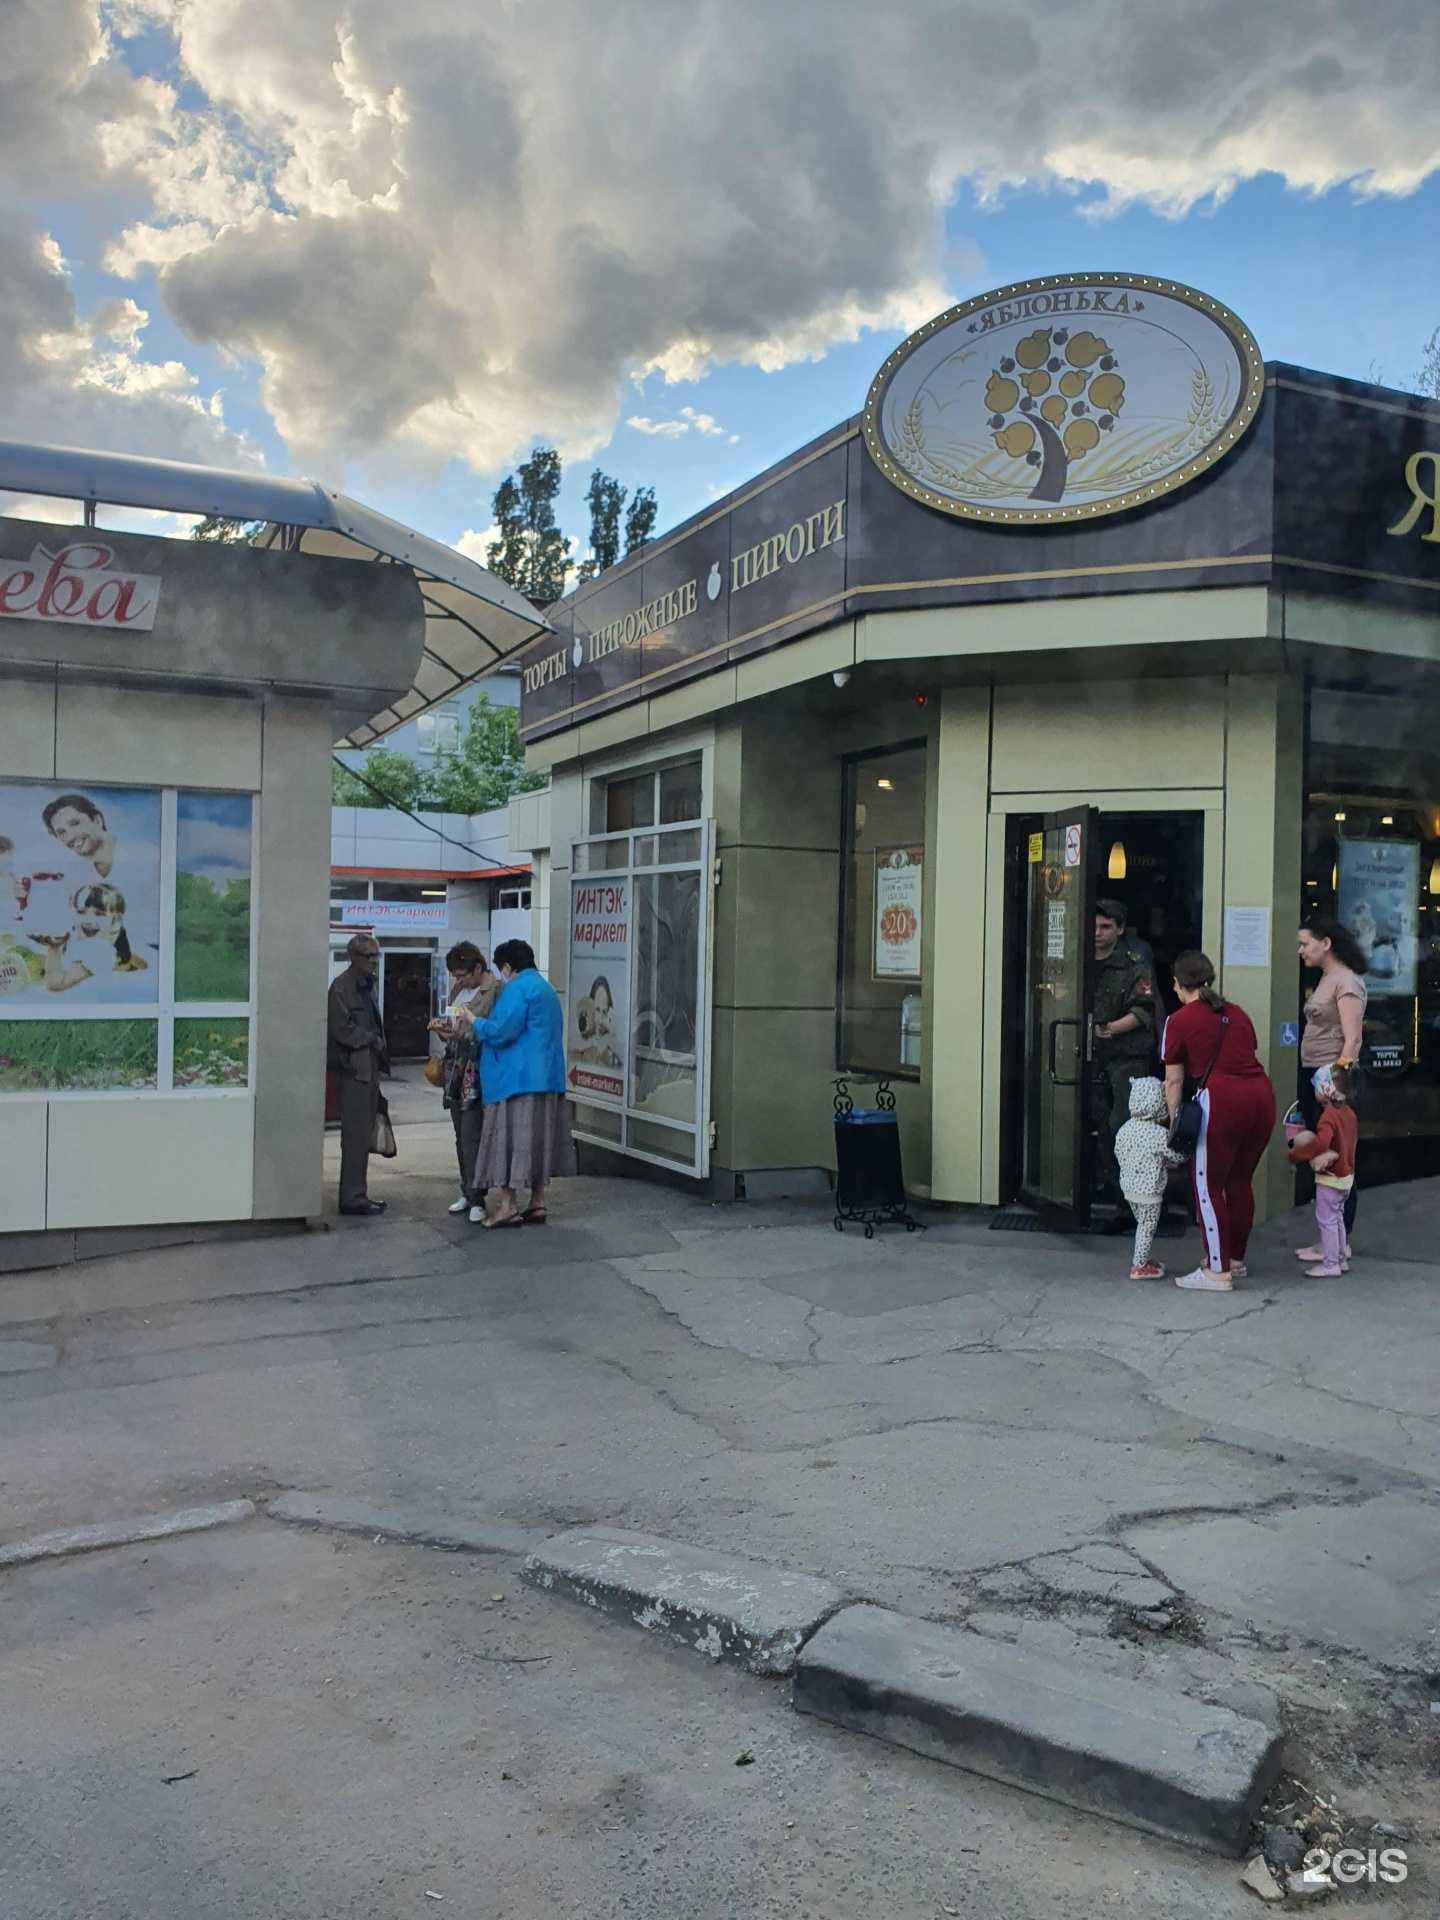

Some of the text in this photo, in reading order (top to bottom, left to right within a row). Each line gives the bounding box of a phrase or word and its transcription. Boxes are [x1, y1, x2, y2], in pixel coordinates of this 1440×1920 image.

[1386, 451, 1440, 542] Я
[523, 499, 848, 694] ТОРТЫ ПИРОЖНЫЕ ПИРОГИ
[574, 920, 627, 949] маркет
